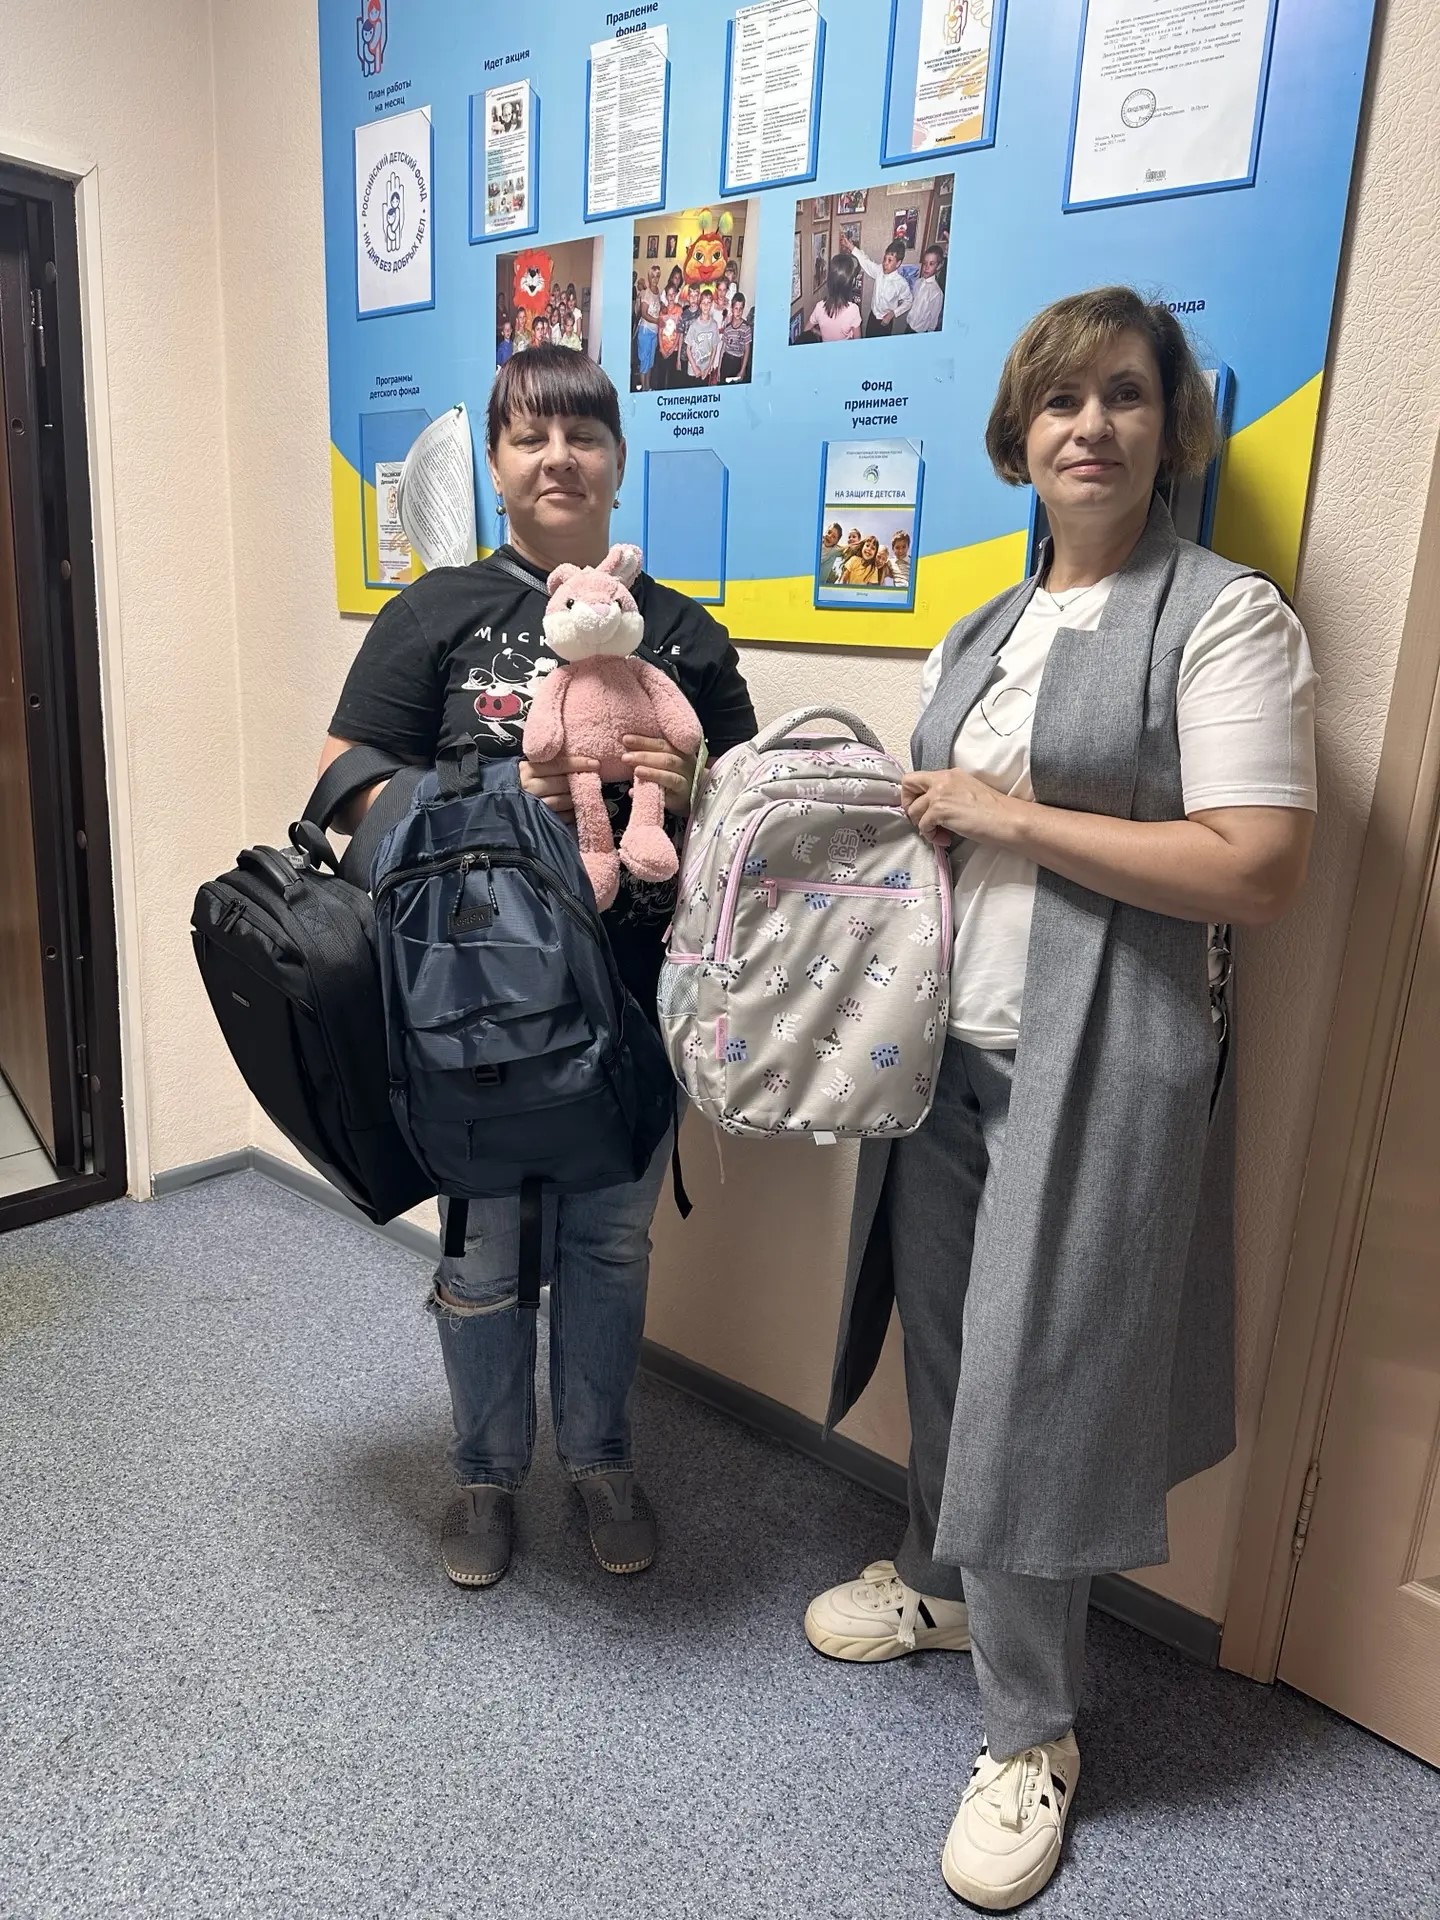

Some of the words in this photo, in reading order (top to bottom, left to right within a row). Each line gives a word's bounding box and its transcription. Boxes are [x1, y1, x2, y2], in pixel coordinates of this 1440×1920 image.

[606, 1, 659, 26] Правление
[615, 20, 647, 37] фонда
[484, 56, 504, 72] Идет
[505, 49, 531, 67] акция
[368, 89, 385, 101] План
[386, 79, 412, 97] работы
[374, 103, 383, 112] на
[384, 95, 405, 109] месяц
[362, 153, 389, 217] РОССИЙСКИЙ
[389, 151, 417, 172] ДЕТСКИЙ
[414, 169, 428, 203] ФОНД
[363, 231, 371, 249] НИ
[367, 247, 380, 267] ДНЯ
[379, 259, 392, 273] БЕЗ
[393, 241, 420, 275] ДОБРЫХ
[416, 218, 427, 245] ДЕЛ
[375, 374, 413, 389] Программы
[861, 379, 893, 393] Фонд
[369, 385, 397, 399] детского
[398, 385, 420, 399] фонда
[657, 392, 721, 407] Стипендиаты
[844, 395, 908, 412] принимает
[659, 407, 720, 422] Российского
[852, 413, 898, 428] участие
[673, 423, 704, 438] фонда
[835, 490, 844, 498] НА
[845, 490, 874, 500] ЗАЩИТЕ
[875, 490, 906, 499] ДЕТСТВА
[474, 625, 548, 647] MICK
